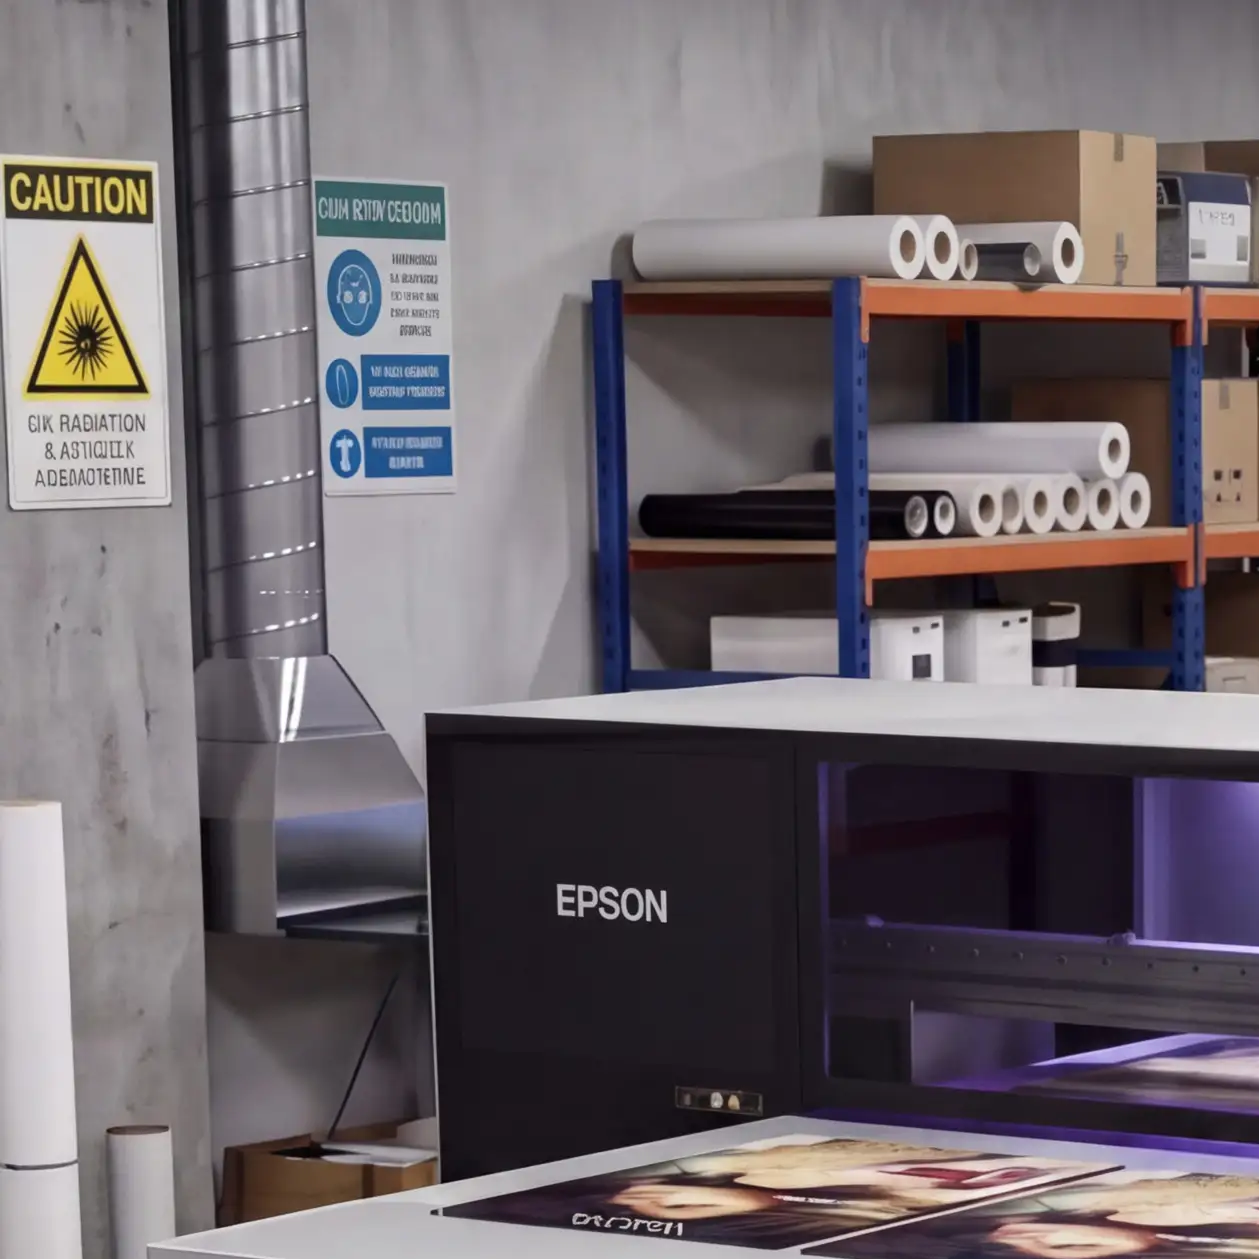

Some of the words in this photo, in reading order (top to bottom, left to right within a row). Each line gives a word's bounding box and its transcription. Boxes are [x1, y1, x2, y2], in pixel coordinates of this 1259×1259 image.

[10, 171, 147, 215] CAUTION
[60, 413, 145, 432] RADIATION
[556, 883, 668, 923] EPSON
